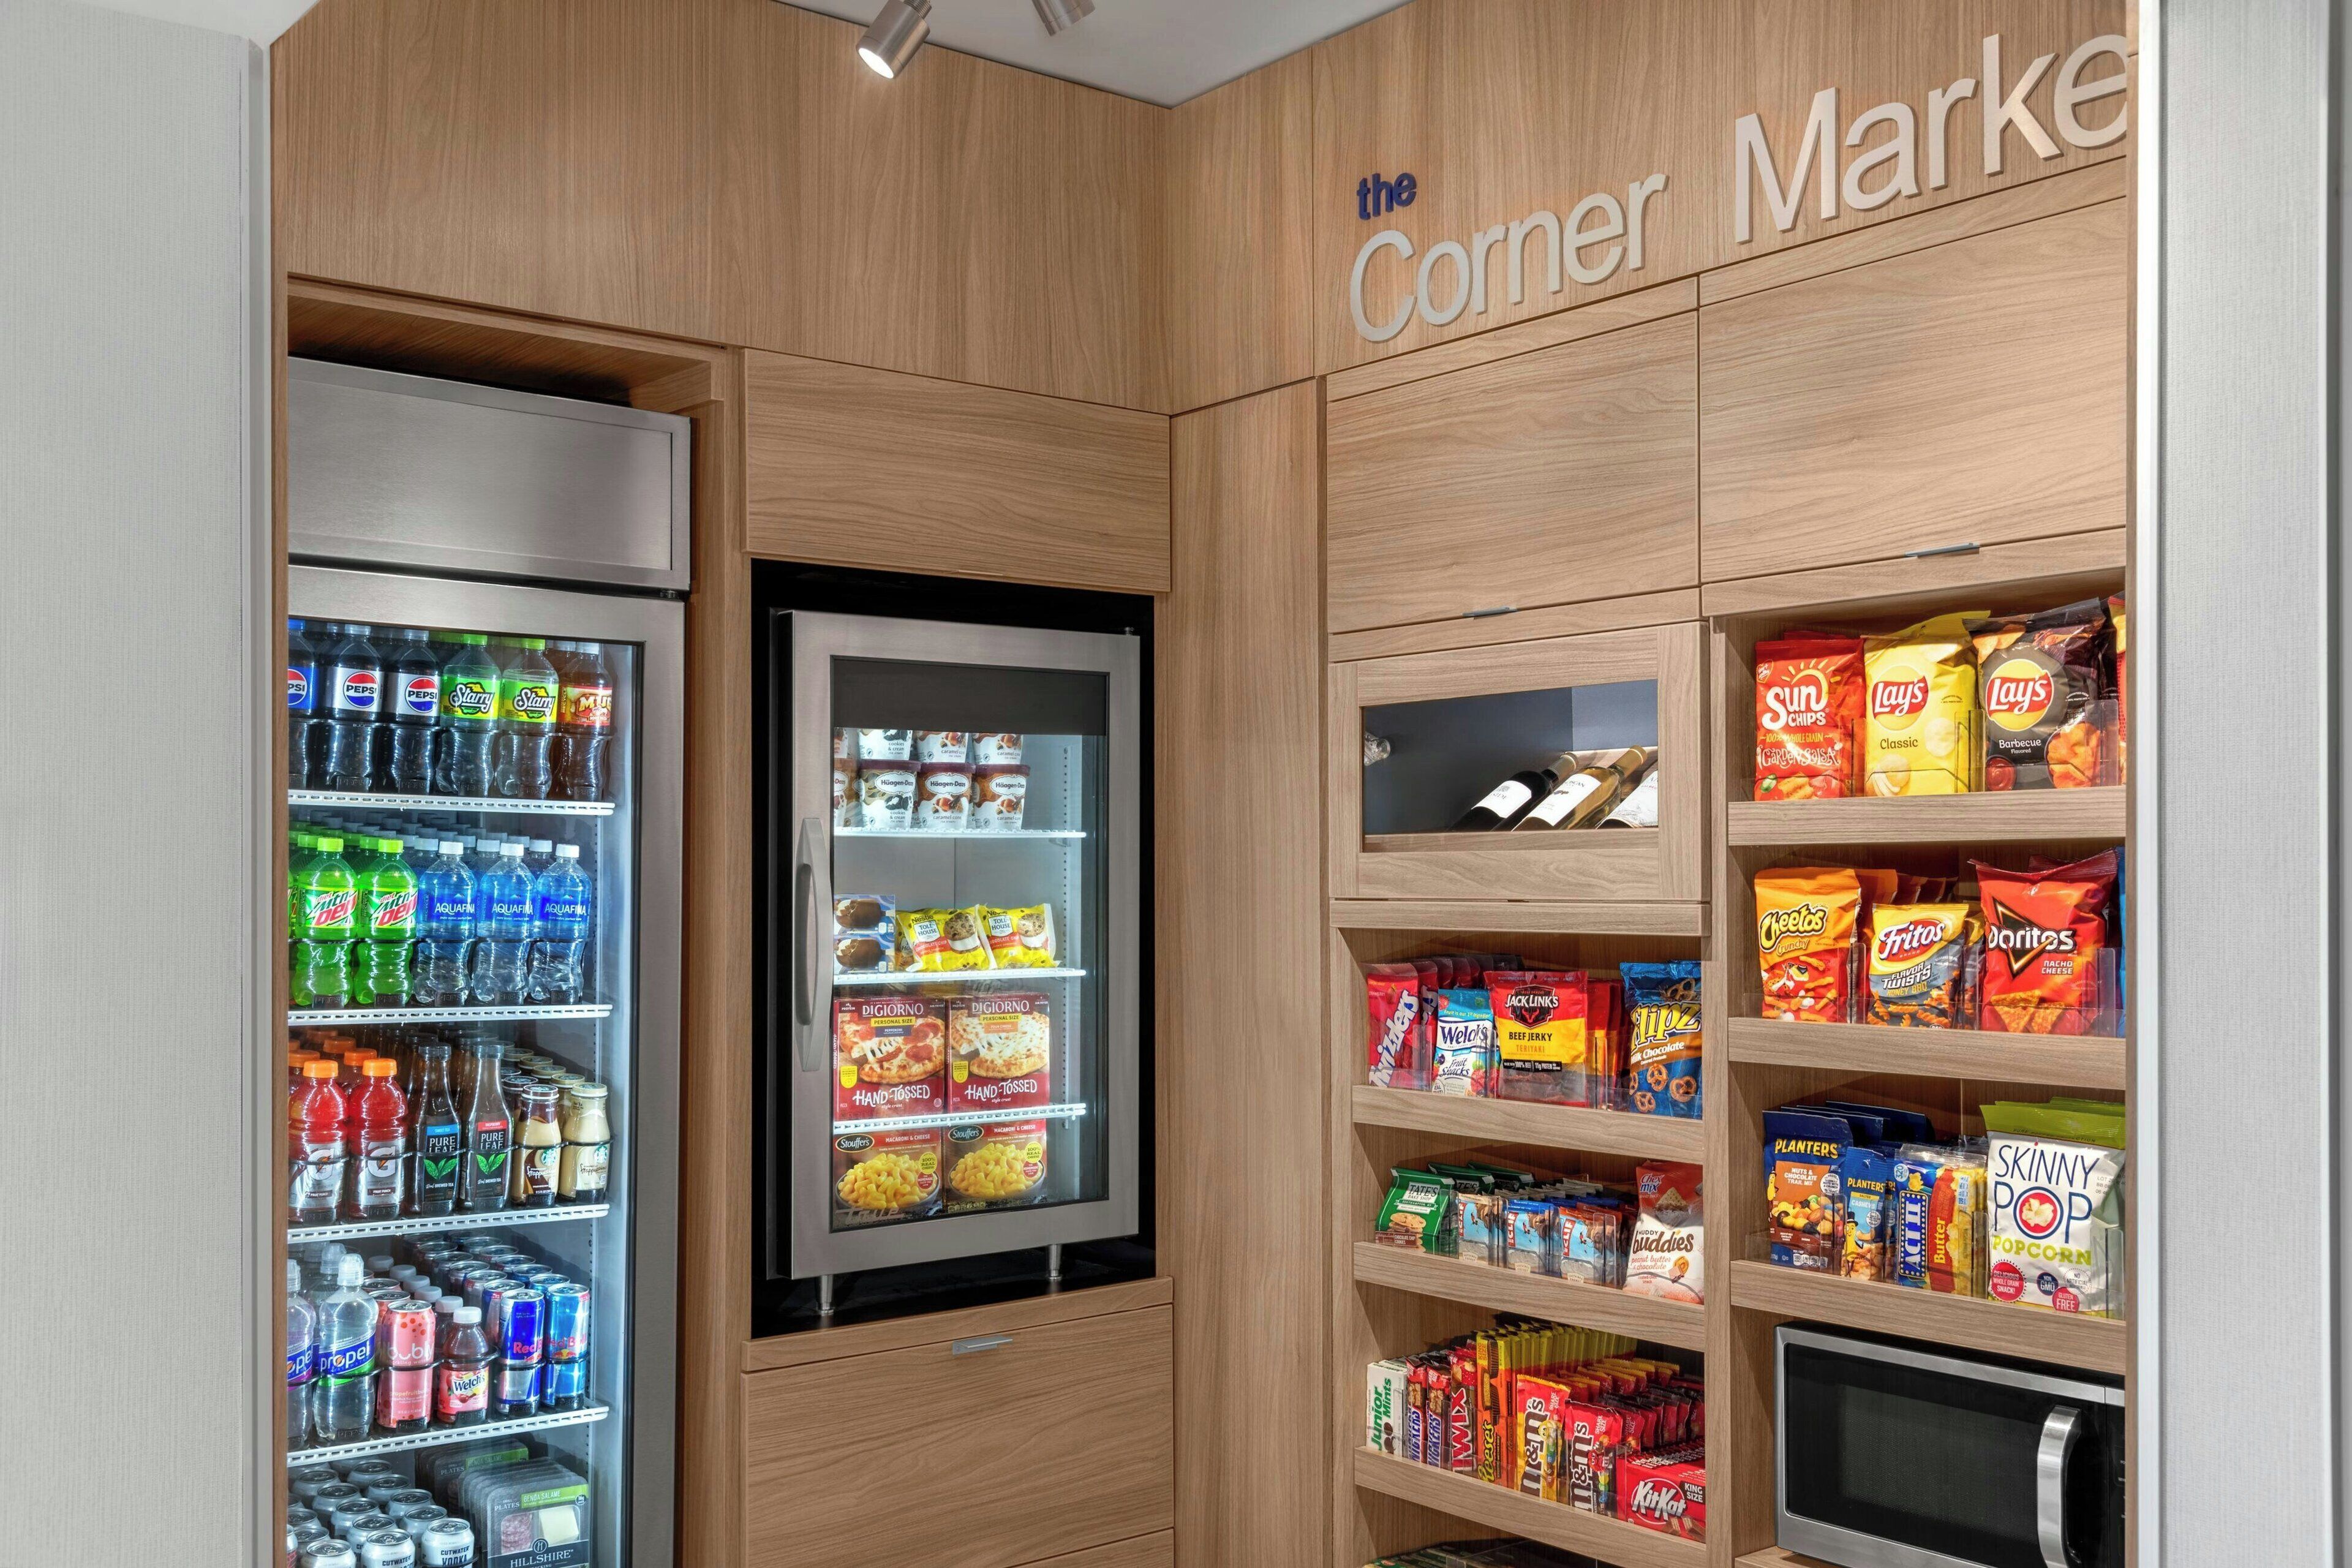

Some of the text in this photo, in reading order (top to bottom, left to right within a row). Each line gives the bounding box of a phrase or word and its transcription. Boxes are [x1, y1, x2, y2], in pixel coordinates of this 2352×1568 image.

[1356, 170, 1417, 219] the
[1350, 173, 1669, 342] Corner
[408, 690, 437, 699] PEPSI
[450, 682, 495, 713] Starry
[1873, 677, 1926, 717] Lay's
[1988, 675, 2048, 715] Lay's
[1762, 684, 1829, 730] Sun
[1787, 712, 1827, 727] CHIPS
[1806, 733, 1823, 742] GRAIN
[1880, 737, 1918, 750] Classic
[1999, 737, 2041, 749] Barbecue
[435, 902, 475, 915] AQUAFINA
[1760, 904, 1826, 951] Cheetos
[1879, 921, 1946, 960] Fritos
[1988, 924, 2075, 950] Doritos
[1776, 938, 1810, 957] Crunchy
[1882, 964, 1932, 990] TWISTS
[1891, 962, 1925, 980] FLAVOR
[1887, 982, 1928, 996] HONEY BBQ
[1505, 994, 1559, 1008] JACK LINK'S
[1509, 1031, 1553, 1042] BEEF JERKY
[1516, 1044, 1545, 1054] TERIYAKI
[1631, 1041, 1684, 1065] Milk Chocolate
[1450, 1058, 1467, 1069] Fruit
[1439, 1066, 1470, 1077] Snacks
[481, 1131, 504, 1142] PURE
[952, 1128, 980, 1140] Stouffer's
[429, 1136, 456, 1147] PURE
[840, 1137, 870, 1150] Stouffer's
[1774, 1138, 1838, 1159] PLANTERS
[1995, 1140, 2100, 1190] SKINNY
[1640, 1174, 1665, 1184] Chex
[1784, 1172, 1818, 1181] CHOCOLATE
[1409, 1184, 1439, 1197] TATE'S
[1640, 1183, 1660, 1194] mix
[1847, 1177, 1885, 1193] PLANTERS
[1994, 1180, 2092, 1244] POP
[1633, 1229, 1694, 1254] buddies
[1905, 1200, 1921, 1270] ACT II
[1934, 1217, 1946, 1264] Butter
[1992, 1235, 2092, 1266] POPCORN
[1631, 1254, 1672, 1264] peanut butter
[1994, 1271, 2019, 1281] DELICIOUS
[2040, 1280, 2055, 1292] GMO
[2056, 1299, 2076, 1311] FREE
[513, 1341, 537, 1354] Red
[321, 1340, 370, 1372] propel
[454, 1372, 485, 1392] Welch's
[1382, 1378, 1392, 1419] Mints
[1371, 1385, 1383, 1451] Junior
[1451, 1387, 1473, 1472] TWIX
[1478, 1419, 1495, 1483] Reese's
[1684, 1482, 1703, 1494] KING
[524, 1490, 561, 1503] GENOA SALAME
[1631, 1480, 1687, 1521] KitKat
[1686, 1491, 1703, 1503] SIZE
[494, 1502, 520, 1511] PLATES
[440, 1545, 470, 1556] CUTWATER
[382, 1555, 412, 1566] CUTWATER
[510, 1550, 571, 1568] HILLSHIRE
